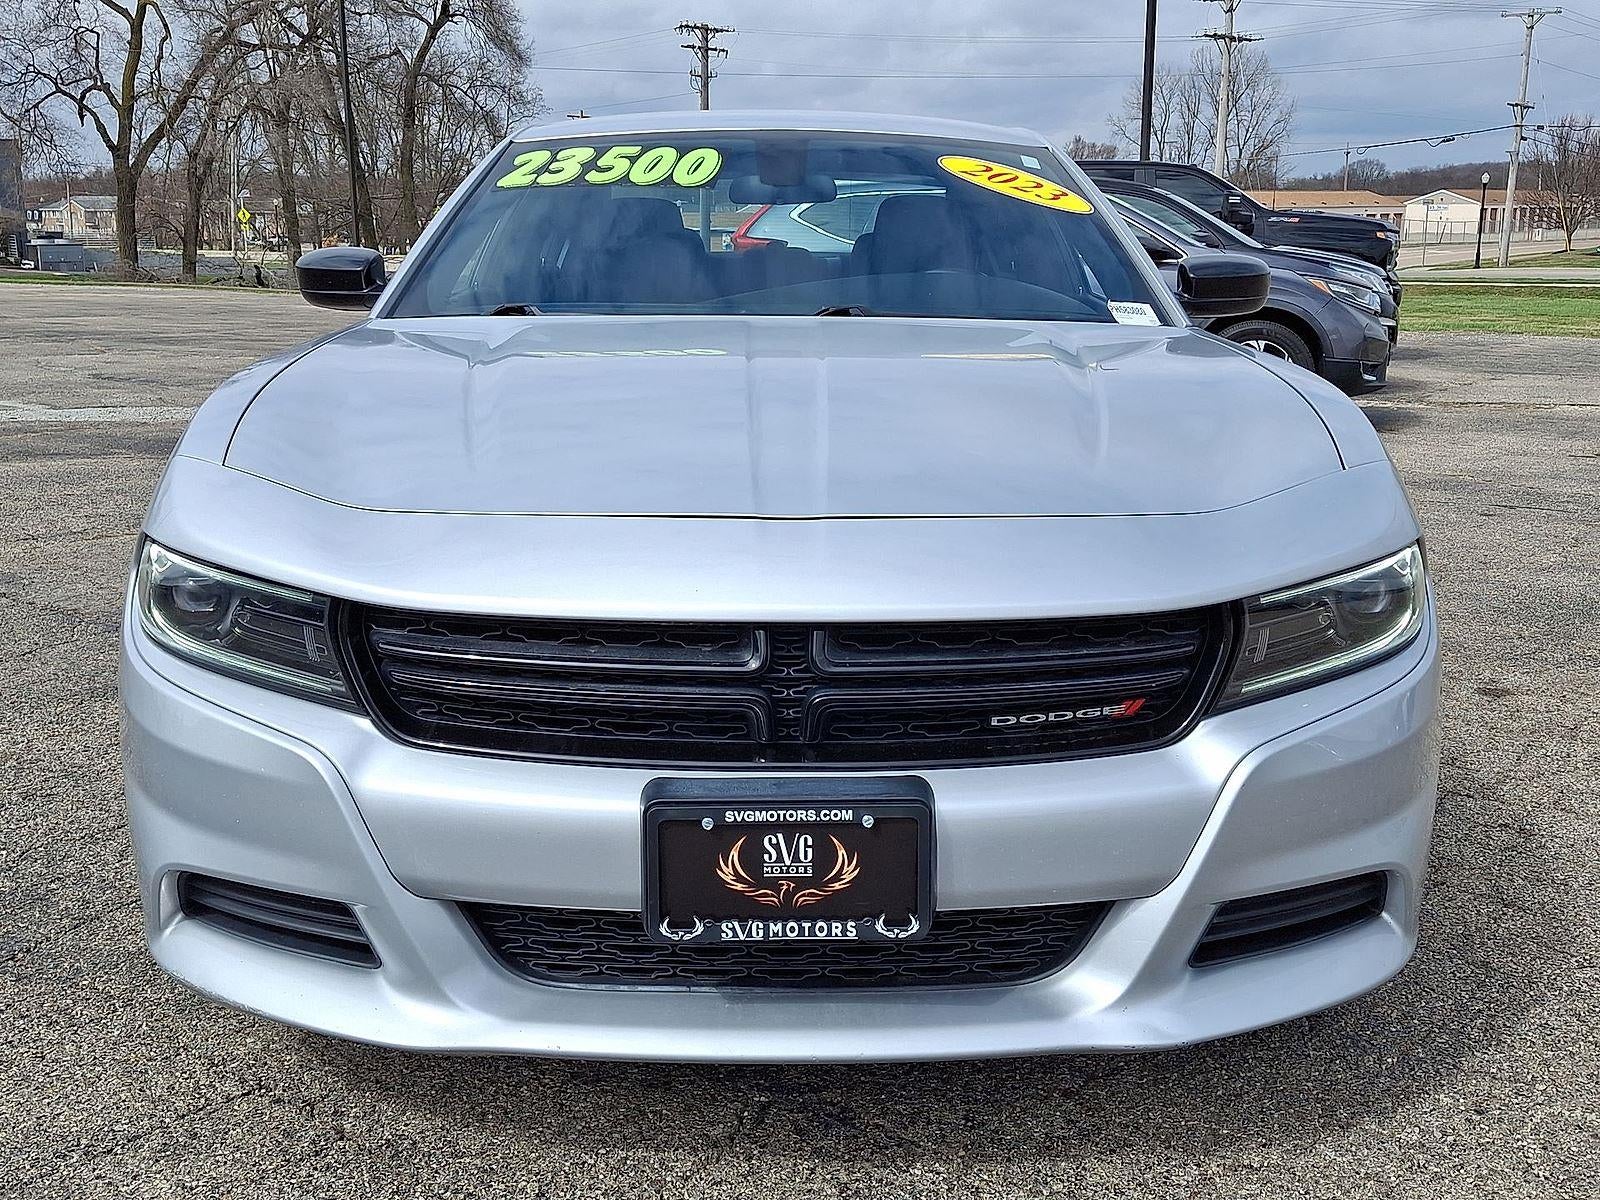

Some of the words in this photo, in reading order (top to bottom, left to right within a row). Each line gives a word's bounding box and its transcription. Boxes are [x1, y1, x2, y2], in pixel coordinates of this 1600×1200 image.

[496, 145, 722, 188] 23500
[959, 164, 1069, 202] 2023
[991, 704, 1126, 726] DODGE
[724, 809, 853, 823] SVGMOTORS.COM
[763, 832, 813, 864] SVG
[763, 866, 813, 874] MOTORS
[721, 919, 763, 938] SVG
[769, 920, 858, 938] MOTORS
